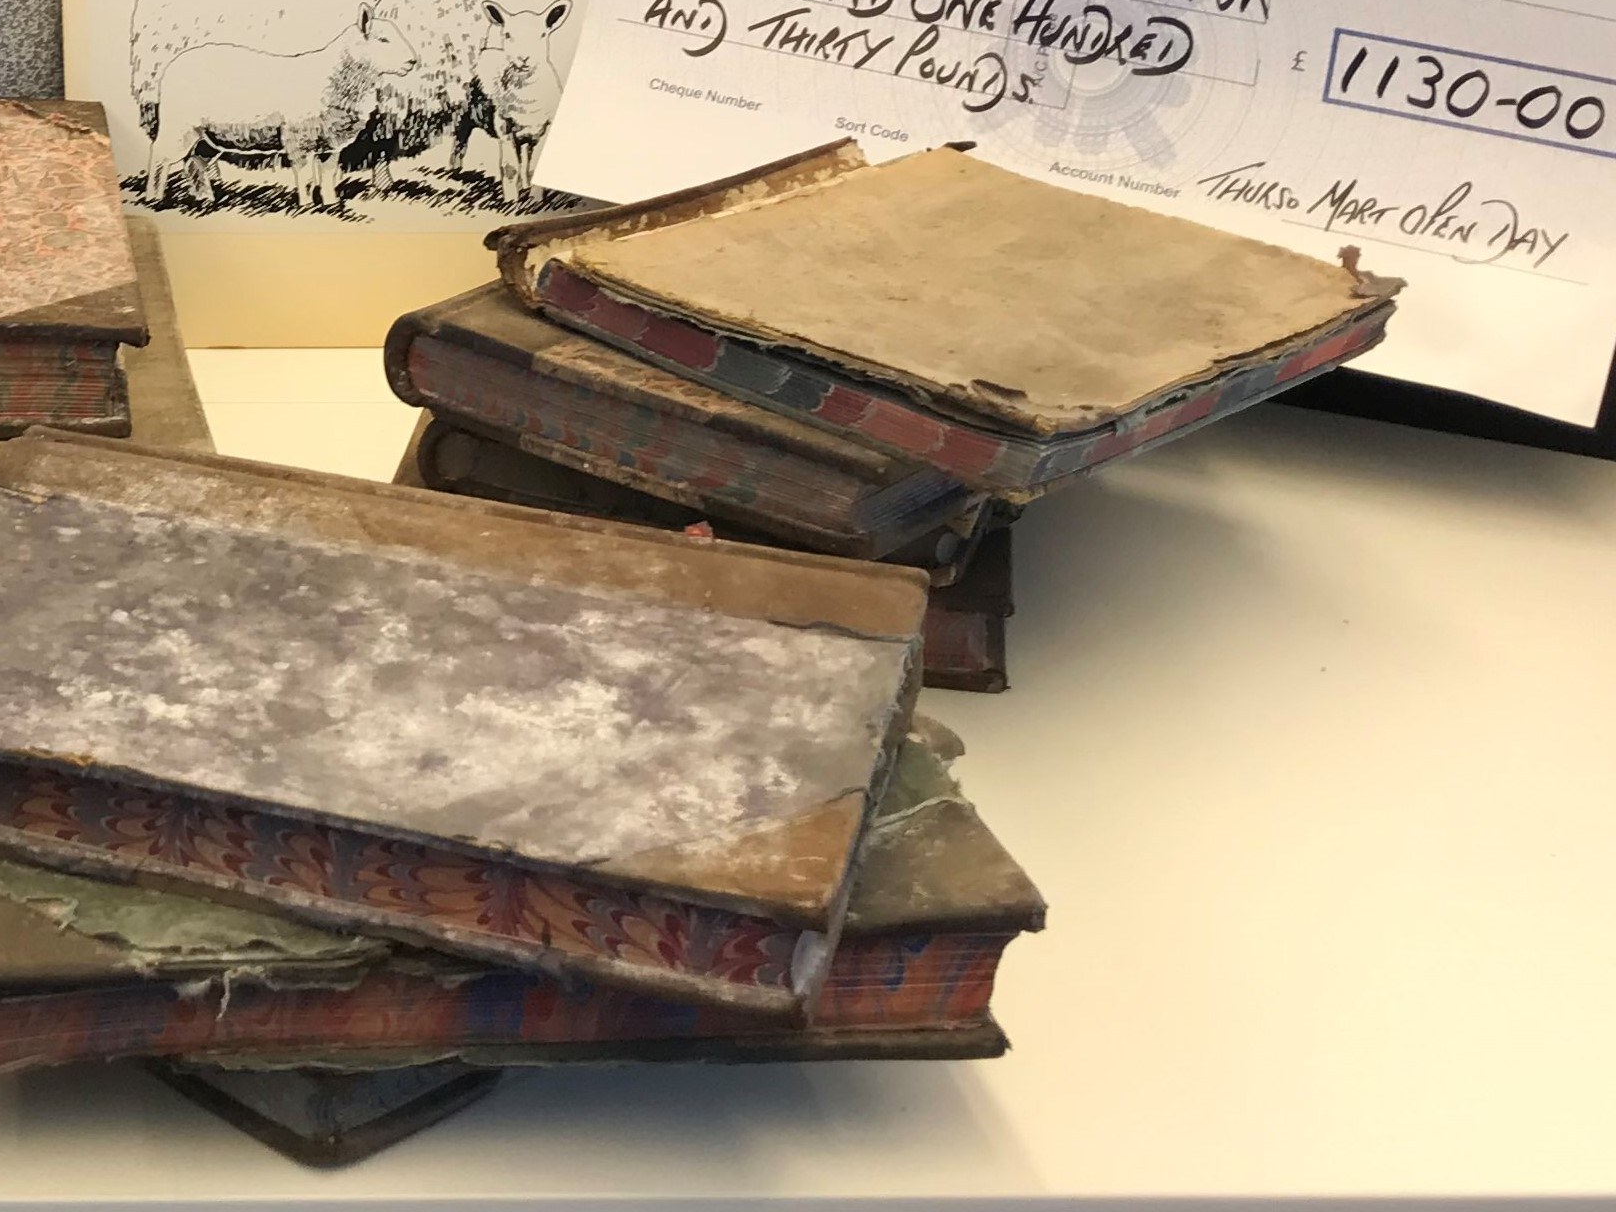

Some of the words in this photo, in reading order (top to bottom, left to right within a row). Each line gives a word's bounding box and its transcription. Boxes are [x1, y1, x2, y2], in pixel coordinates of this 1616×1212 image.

[747, 6, 895, 71] THIRTY
[1290, 50, 1308, 73] £
[648, 77, 703, 102] Cheque
[704, 88, 763, 112] Number
[1340, 46, 1606, 140] 1130-00
[834, 116, 867, 135] Sort
[869, 124, 910, 143] Code
[1049, 161, 1115, 188] Account
[1118, 177, 1182, 201] Number
[1197, 162, 1300, 210] THURSO
[1307, 179, 1399, 232] MART
[1400, 182, 1477, 244] OPEN
[1452, 199, 1569, 268] DAY
